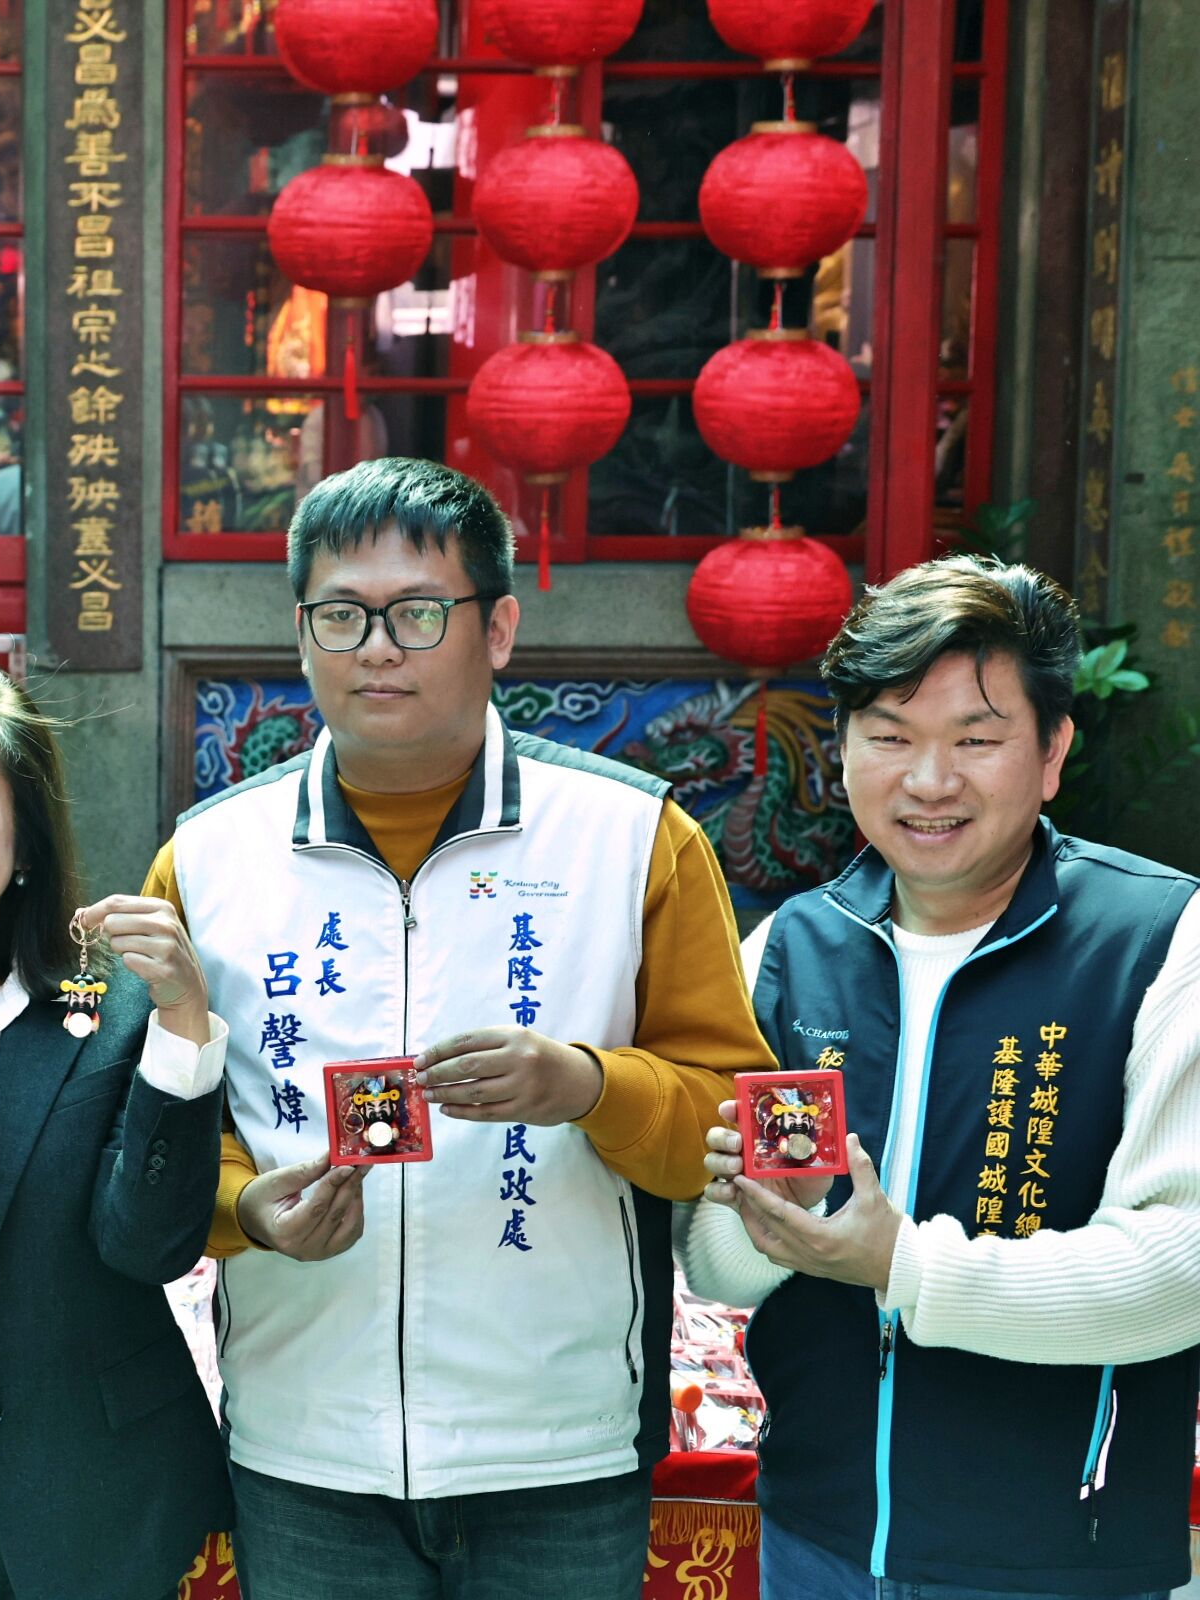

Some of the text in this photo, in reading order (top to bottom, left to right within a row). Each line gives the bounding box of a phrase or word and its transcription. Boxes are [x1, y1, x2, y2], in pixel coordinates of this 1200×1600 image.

[541, 880, 560, 890] City
[314, 911, 350, 997] 處長
[497, 1123, 538, 1253] 民政處
